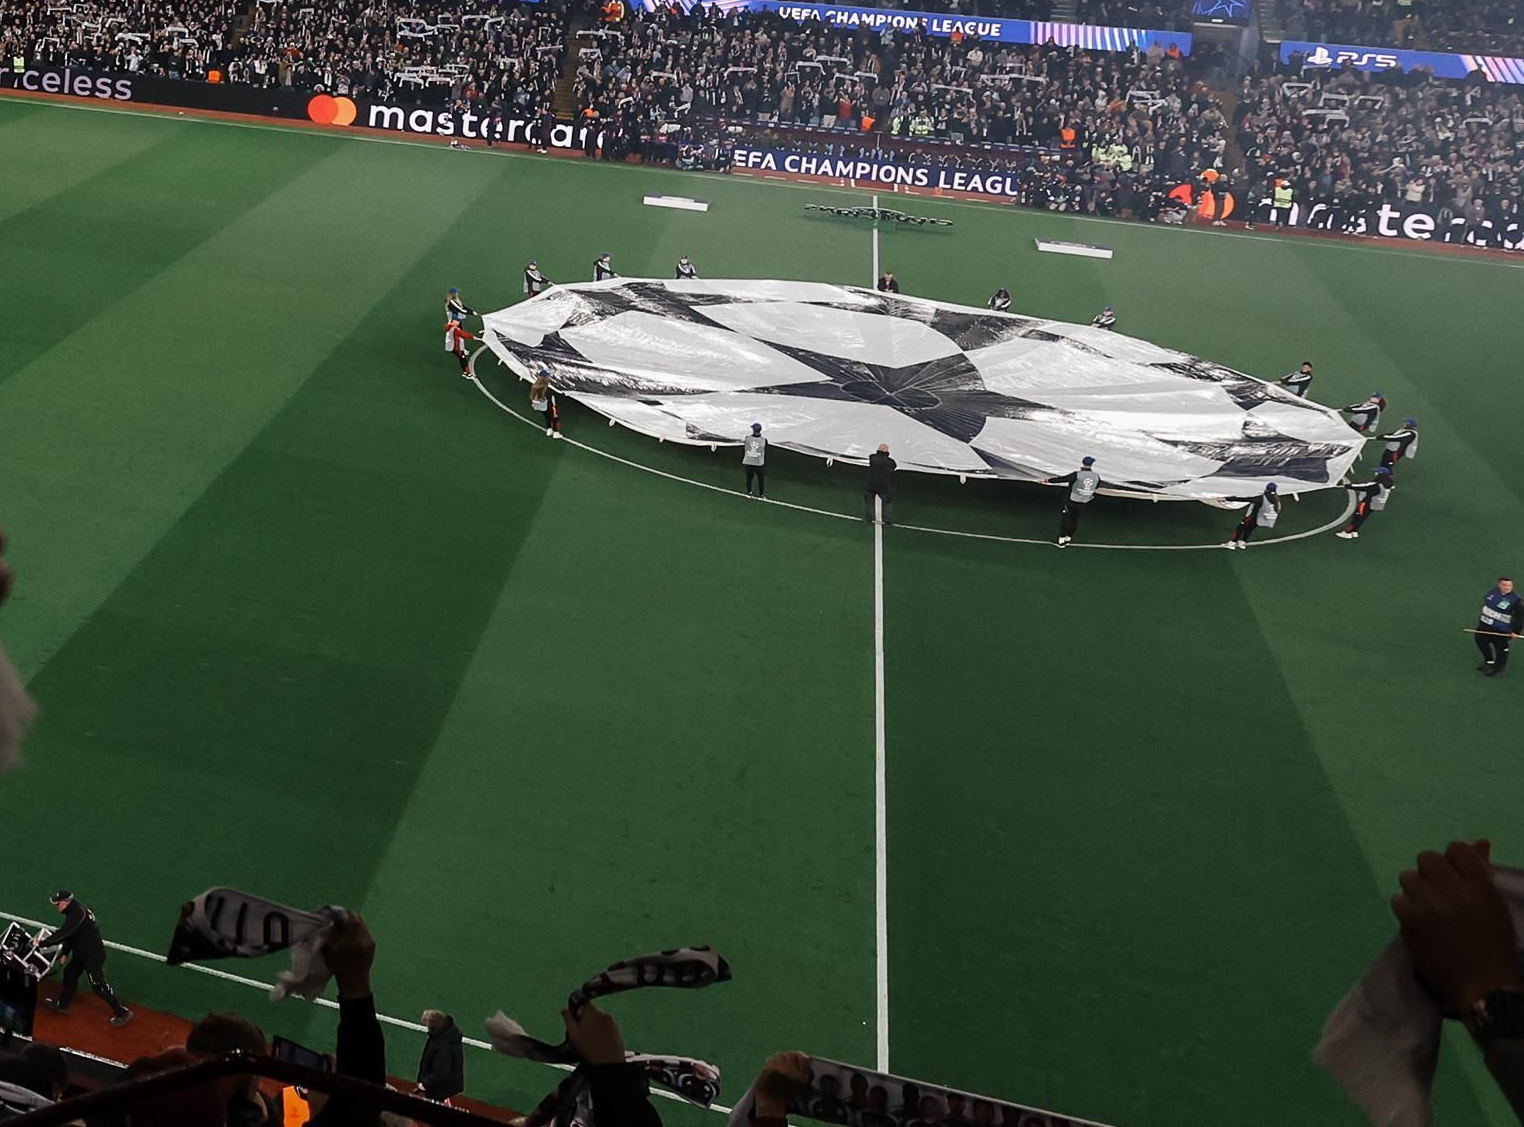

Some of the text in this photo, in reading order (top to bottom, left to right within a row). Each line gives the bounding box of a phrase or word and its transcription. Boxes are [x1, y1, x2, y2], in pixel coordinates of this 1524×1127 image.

[1336, 51, 1398, 68] PS5
[733, 149, 1018, 197] EFA CHAMPIONS LEAGU
